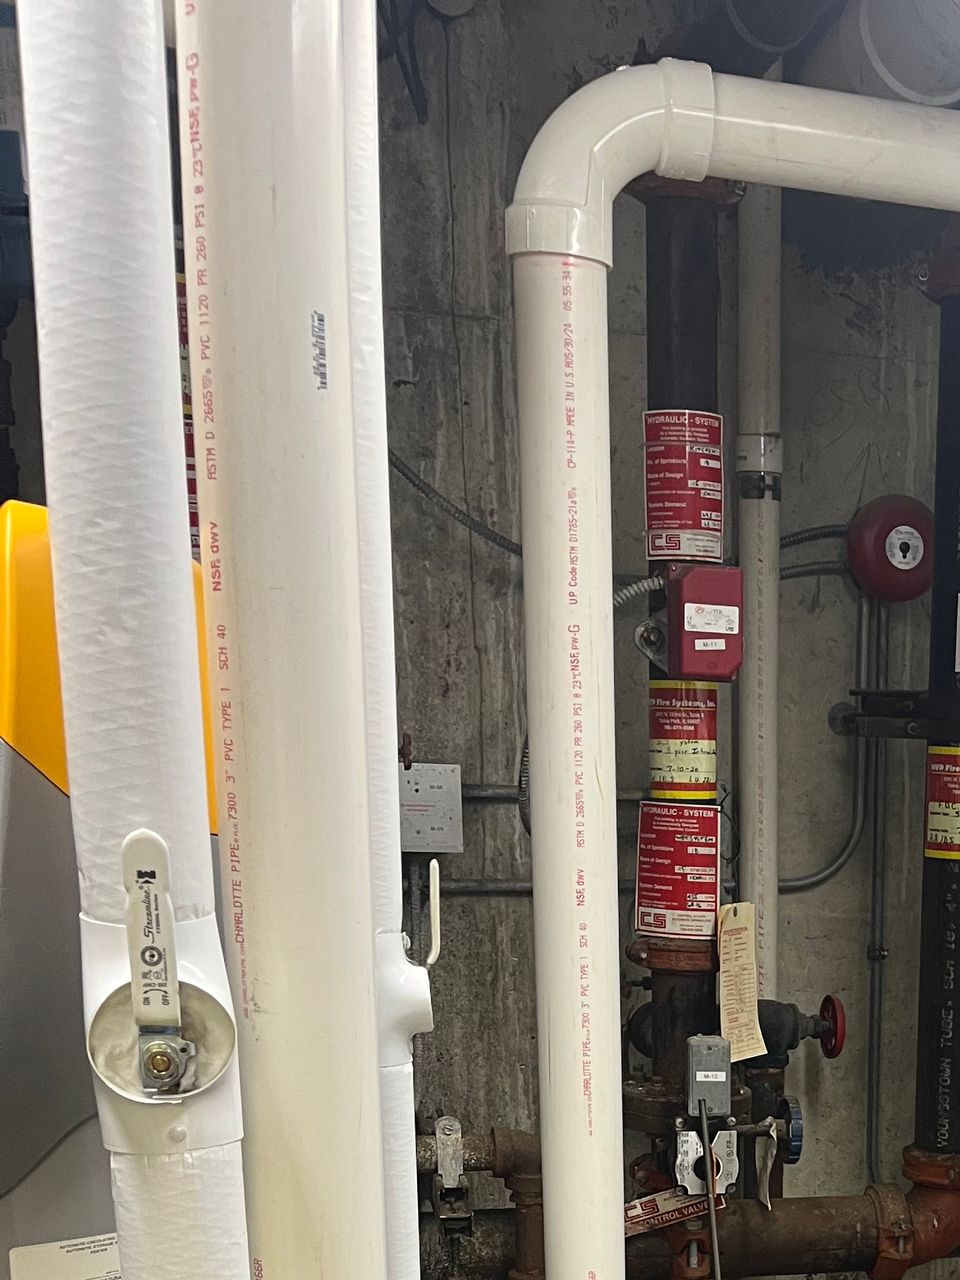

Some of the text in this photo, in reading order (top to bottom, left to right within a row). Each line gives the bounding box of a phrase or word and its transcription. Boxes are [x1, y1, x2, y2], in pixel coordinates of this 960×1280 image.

[194, 203, 205, 228] PSI
[196, 235, 207, 261] 260
[197, 268, 208, 286] PR
[198, 294, 209, 325] 1120
[200, 335, 210, 360] PVC
[566, 391, 575, 402] IN
[202, 390, 214, 423] 2665
[566, 406, 575, 427] MADE
[647, 415, 719, 427] HYDRAULIC SYSTEM
[205, 431, 215, 440] D
[206, 447, 217, 480] ASTM
[209, 521, 220, 554] dwv
[569, 546, 578, 566] ASTM
[568, 566, 578, 587] Code
[568, 591, 578, 605] UP
[216, 624, 226, 639] 40
[568, 624, 580, 650] pw-G
[218, 647, 228, 670] SCH
[221, 701, 232, 730] TYPE
[573, 702, 583, 716] PSI
[574, 719, 583, 733] 260
[223, 739, 233, 762] PVC
[574, 736, 583, 747] PR
[574, 750, 583, 767] 1120
[945, 764, 960, 772] Fire
[574, 771, 584, 786] PVC
[227, 792, 238, 821] 7300
[575, 799, 584, 818] 2665
[643, 806, 714, 818] HYDRAULIC SYSTEM
[576, 830, 585, 848] ASTM
[229, 842, 240, 873] PIPE
[575, 868, 585, 887] dwv
[140, 885, 154, 944] Streamline
[231, 879, 244, 943] CHARLOTTE
[579, 922, 587, 931] 40
[579, 934, 588, 948] SCH
[580, 964, 589, 980] TYPE
[161, 993, 169, 1006] OFF
[580, 984, 589, 997] PVC
[142, 997, 150, 1006] ON
[581, 1012, 590, 1029] 7300
[582, 1040, 591, 1057] PIPE
[582, 1060, 592, 1096] CHARLOTTE
[639, 1201, 709, 1227] CONTROL VALVE
